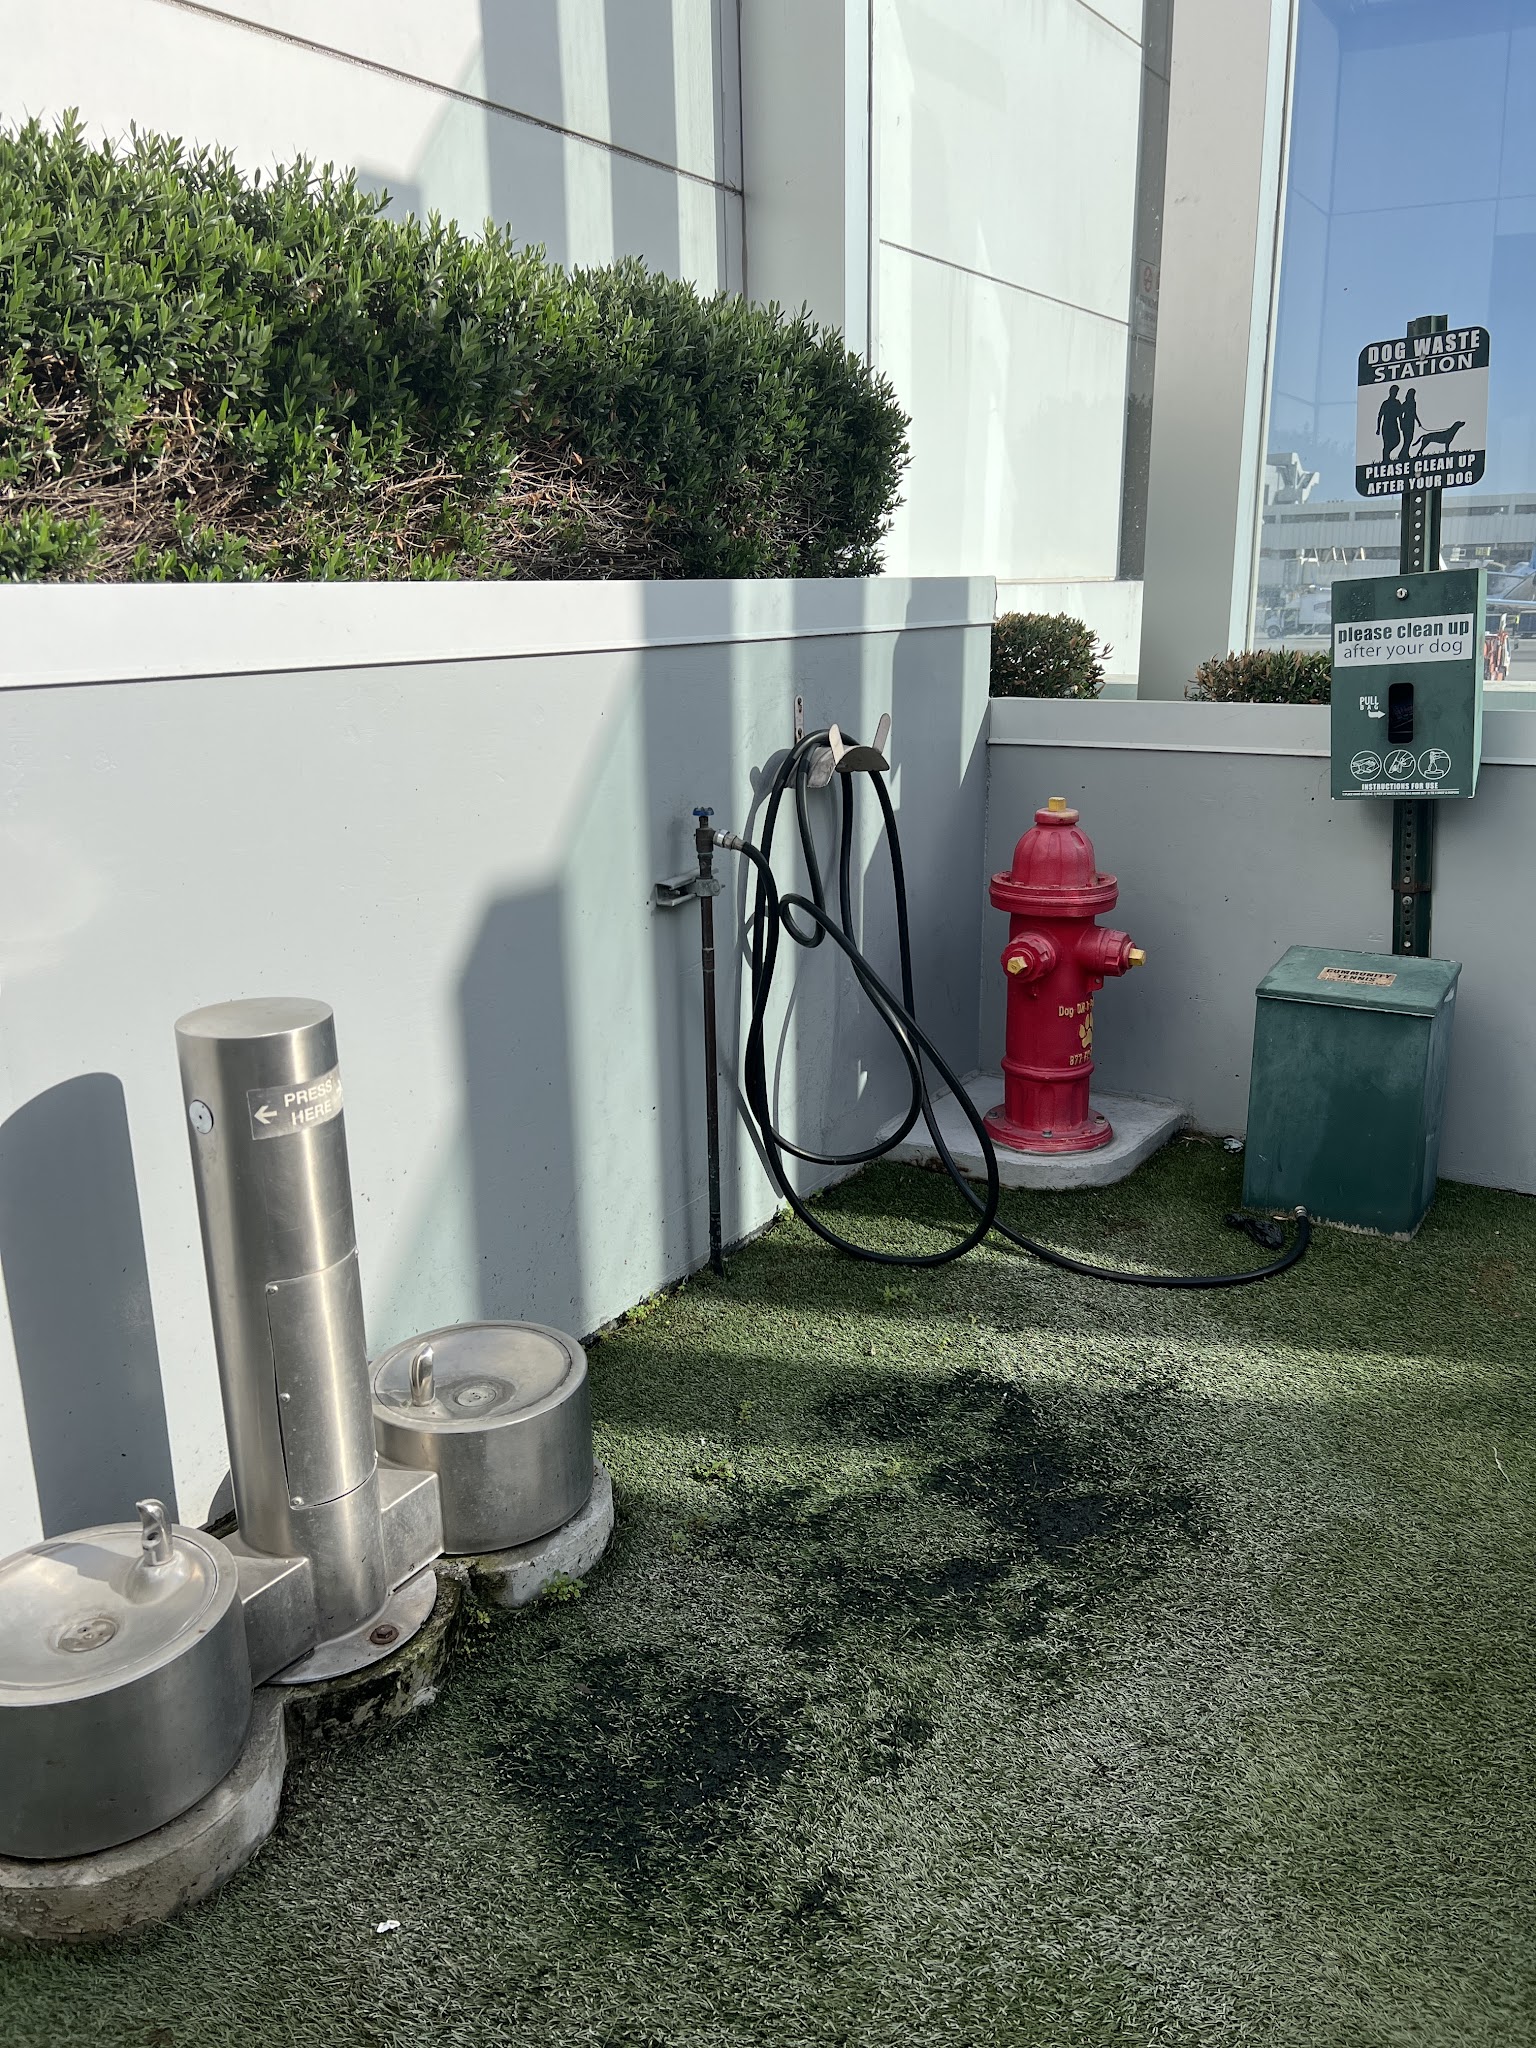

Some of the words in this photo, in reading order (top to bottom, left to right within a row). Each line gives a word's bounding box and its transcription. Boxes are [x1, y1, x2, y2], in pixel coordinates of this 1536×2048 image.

[1368, 341, 1406, 365] DOG
[1413, 330, 1480, 357] WASTE
[1374, 353, 1473, 382] STATION
[1365, 462, 1410, 479] PLEASE
[1414, 457, 1454, 473] CLEAN
[1458, 454, 1476, 468] UP
[1367, 480, 1405, 495] AFTER
[1408, 475, 1442, 490] YOUR
[1446, 471, 1473, 486] DOG
[1338, 627, 1392, 644] please
[1397, 622, 1443, 638] clean
[1448, 620, 1469, 636] up
[1343, 643, 1382, 659] after
[1386, 643, 1424, 660] your
[1429, 638, 1463, 655] dog
[1359, 696, 1379, 705] PULL
[1361, 782, 1410, 791] INSTRUCTIONS
[1411, 782, 1425, 790] FOR
[1425, 782, 1439, 790] USE
[1338, 974, 1376, 982] TENNIS
[284, 1079, 333, 1107] PRESS
[291, 1100, 332, 1126] HERE
